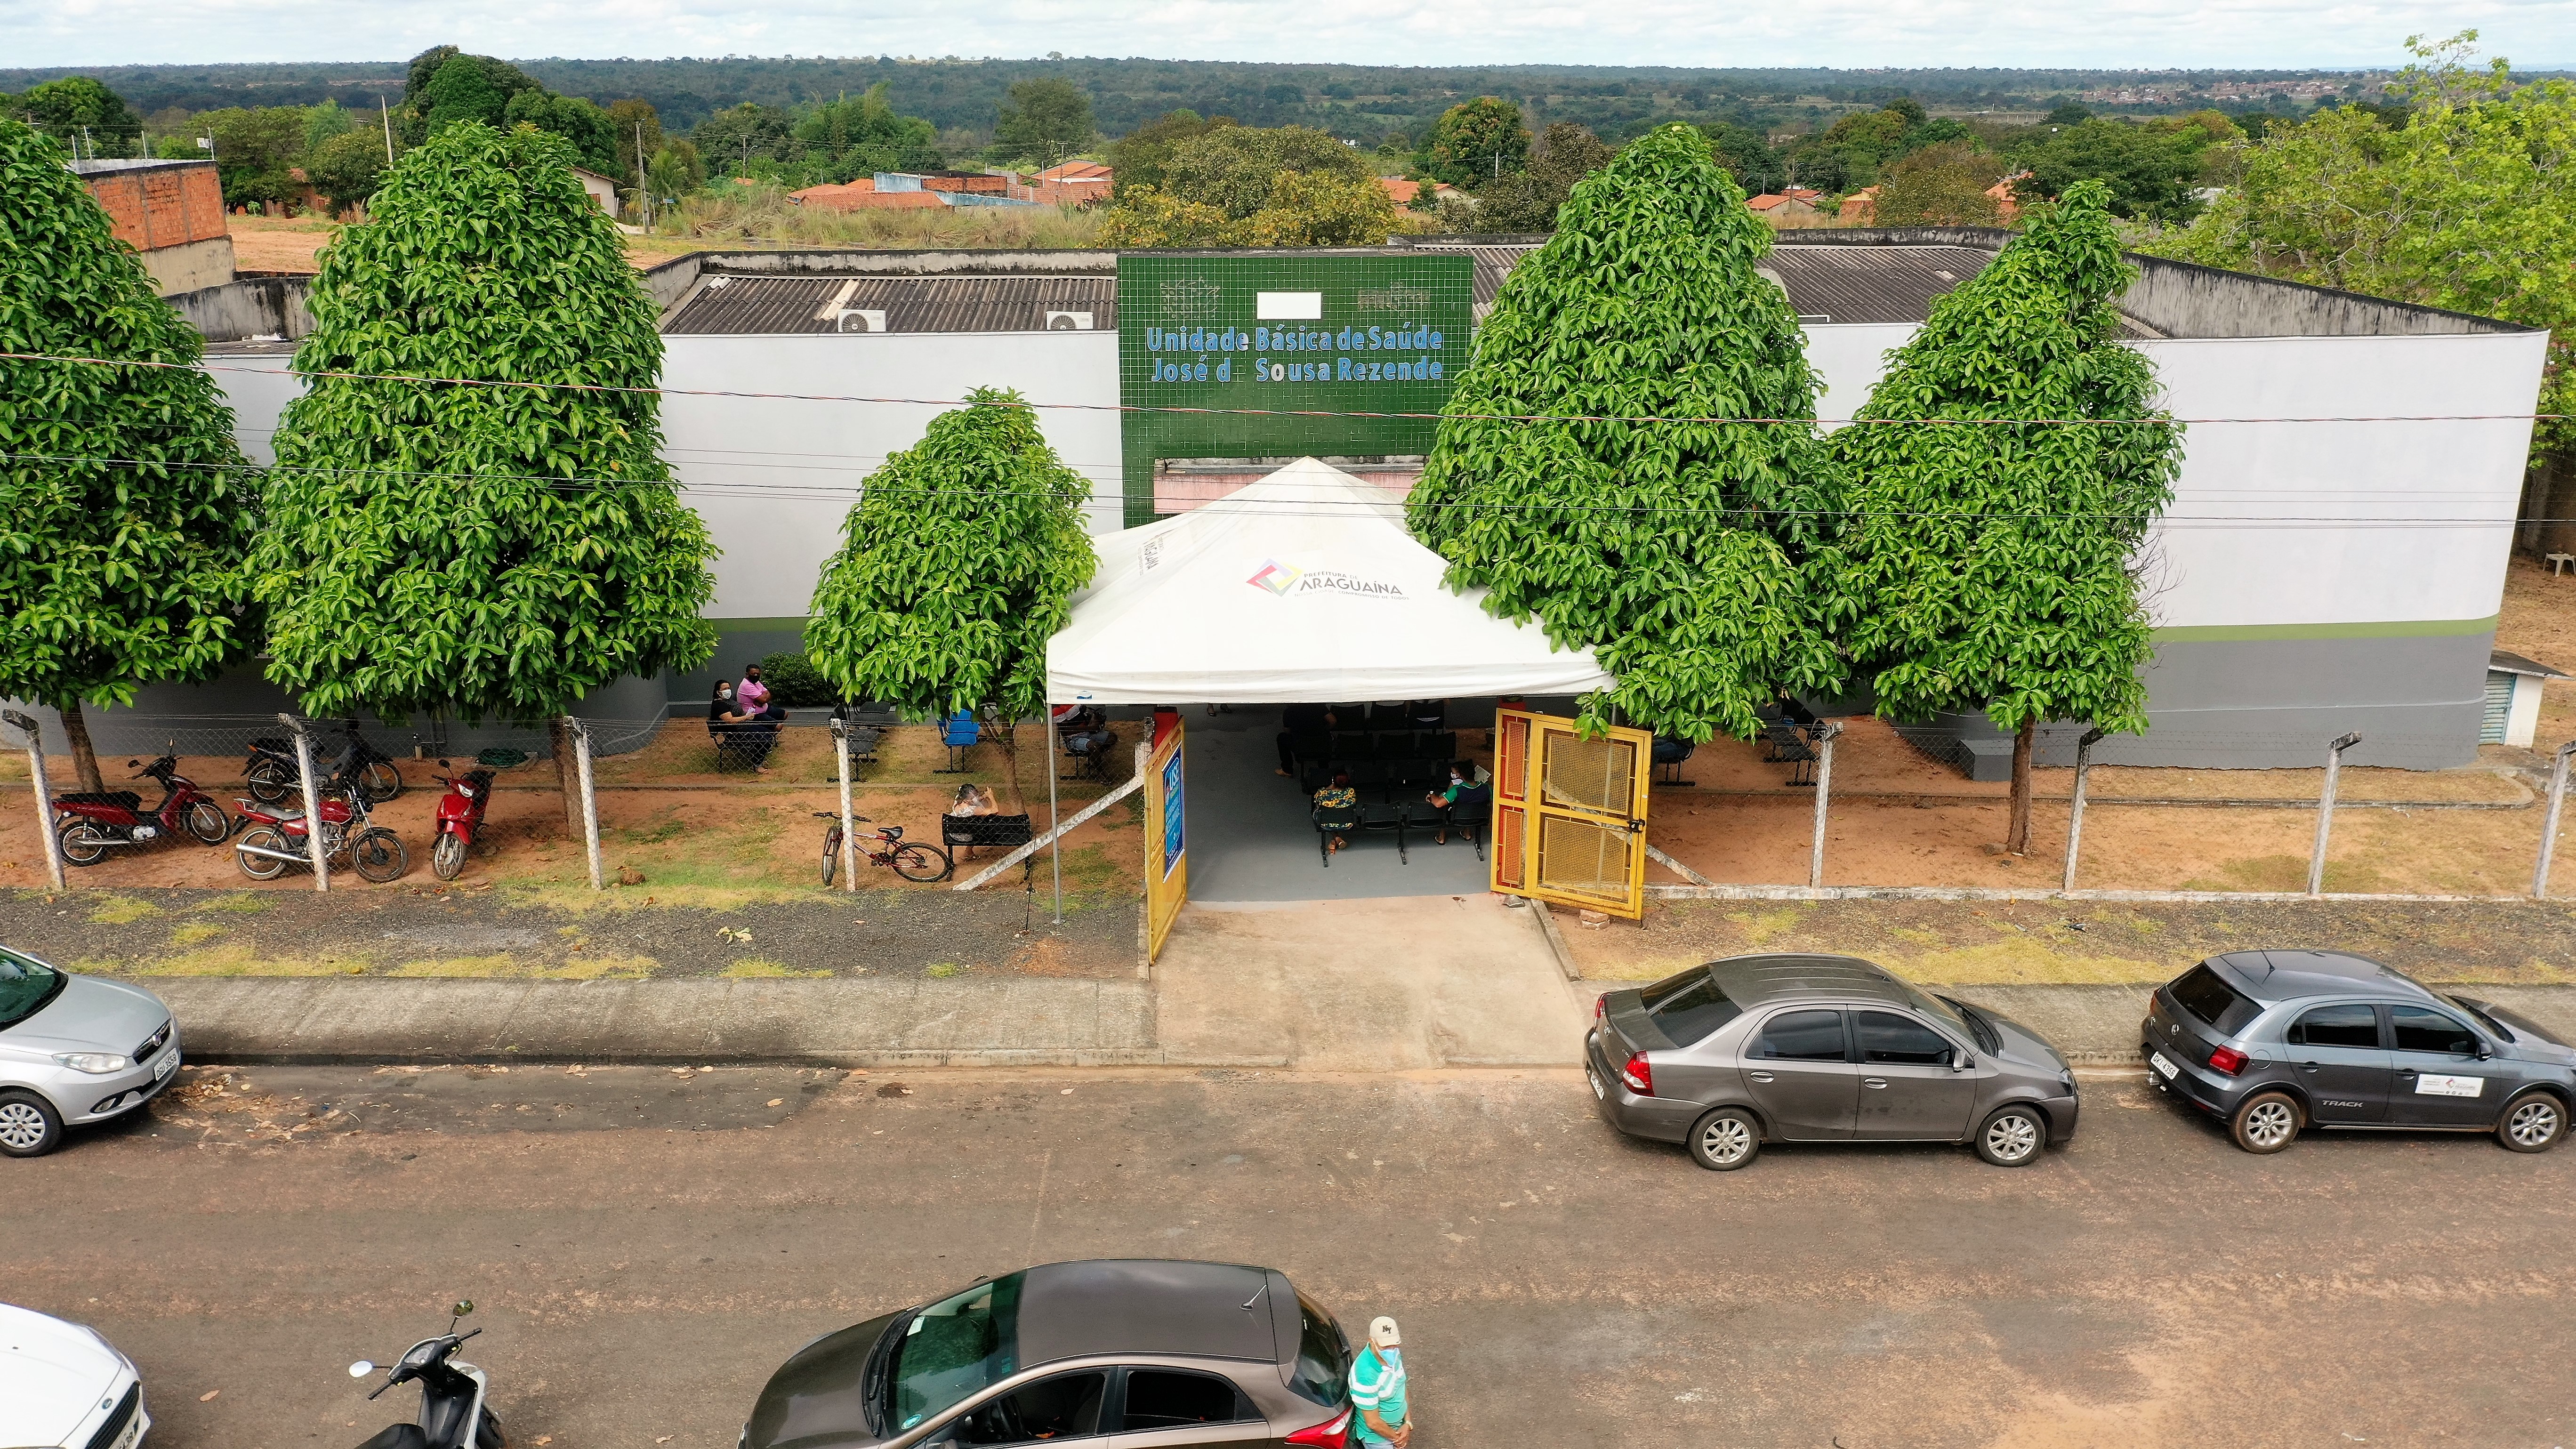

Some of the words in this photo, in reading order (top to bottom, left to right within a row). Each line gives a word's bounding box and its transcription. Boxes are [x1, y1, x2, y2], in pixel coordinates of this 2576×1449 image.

[1147, 326, 1249, 352] Unidade
[1256, 323, 1332, 351] Básica
[1336, 326, 1365, 351] de
[1368, 322, 1443, 350] Saúde
[1151, 355, 1208, 382] José
[1256, 357, 1331, 382] Sousa
[1337, 355, 1443, 381] Rezende
[1300, 577, 1402, 595] ARAGUAÍNA
[1338, 590, 1379, 598] COMPROMISSO
[2322, 1100, 2364, 1108] TRACK
